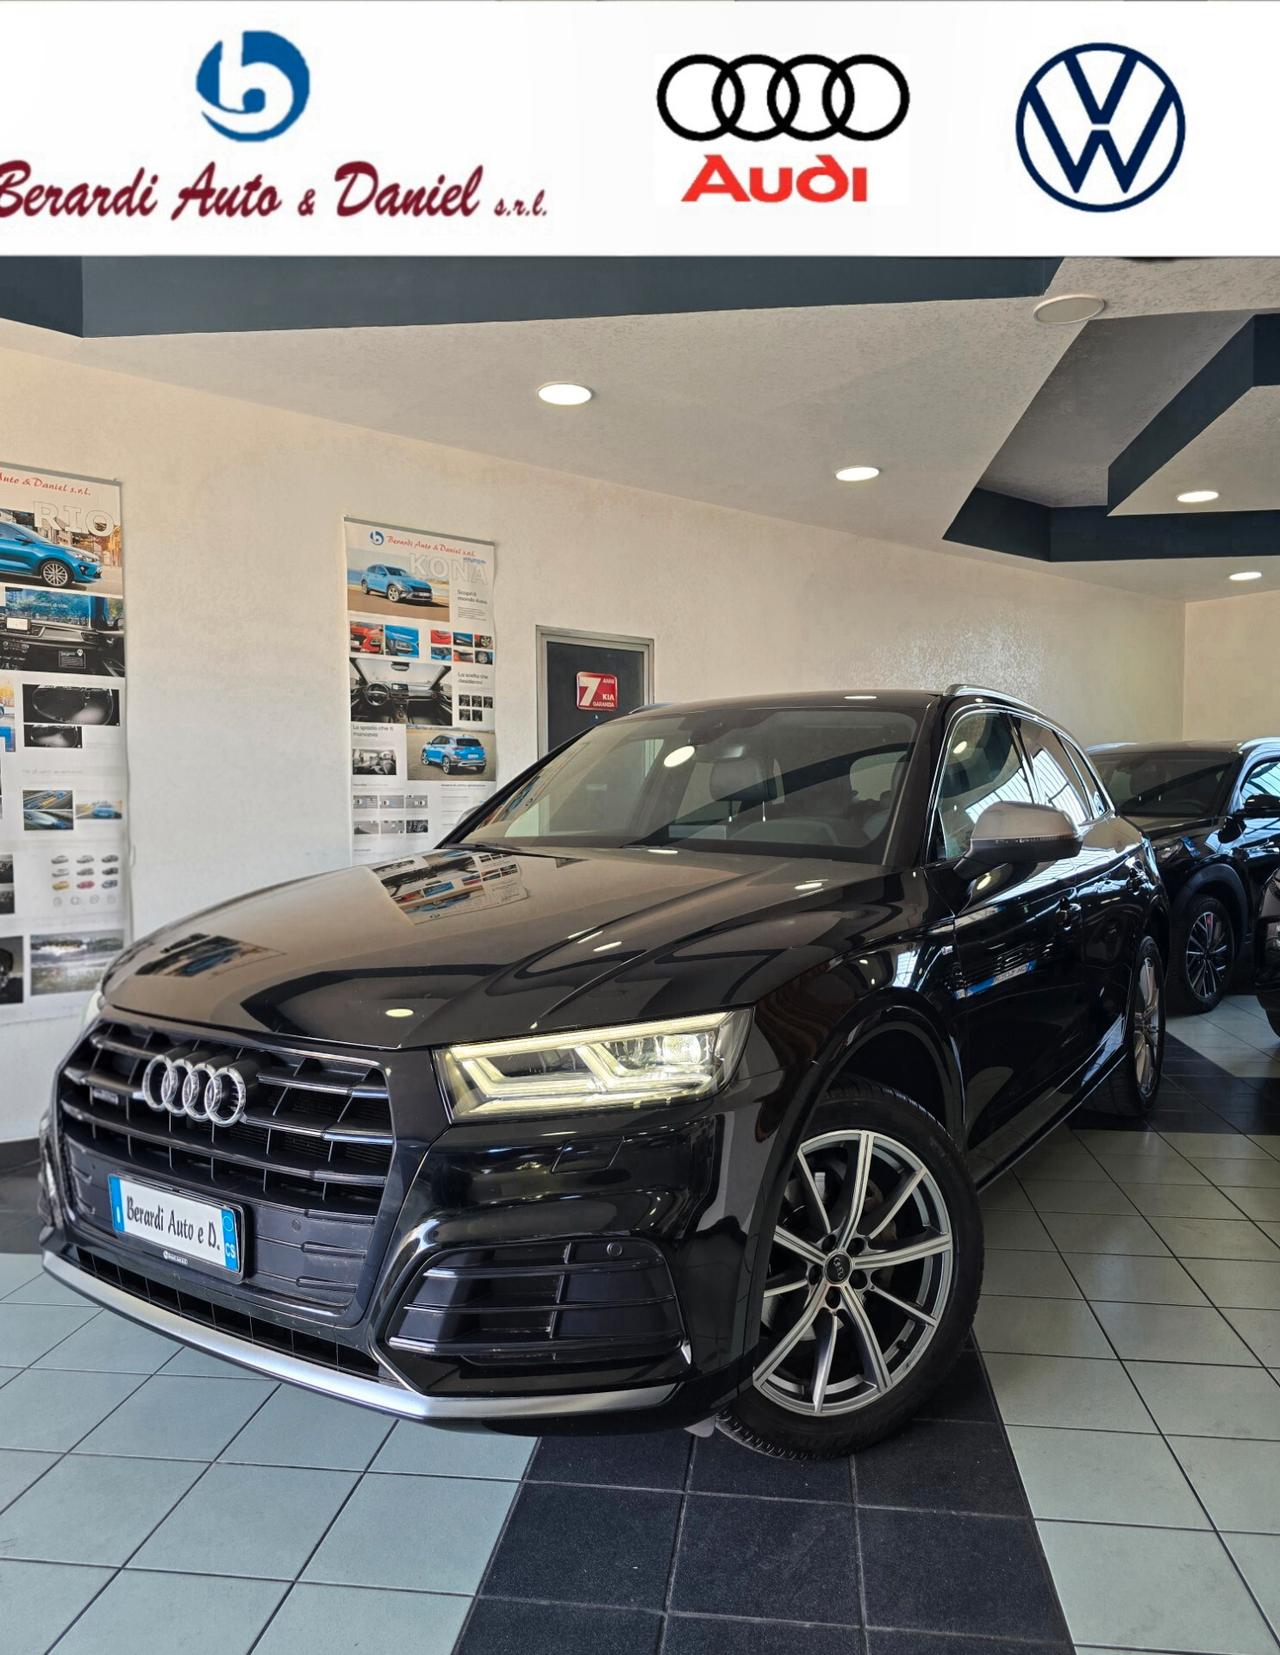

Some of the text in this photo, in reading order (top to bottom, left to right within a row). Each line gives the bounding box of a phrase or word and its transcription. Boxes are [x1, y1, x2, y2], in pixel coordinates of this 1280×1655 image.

[31, 477, 67, 493] Daniel
[33, 500, 114, 537] RIO
[409, 553, 488, 585] KONA
[579, 676, 601, 706] 7
[602, 693, 615, 701] KIA
[126, 1195, 221, 1251] Berardi Auto e D.
